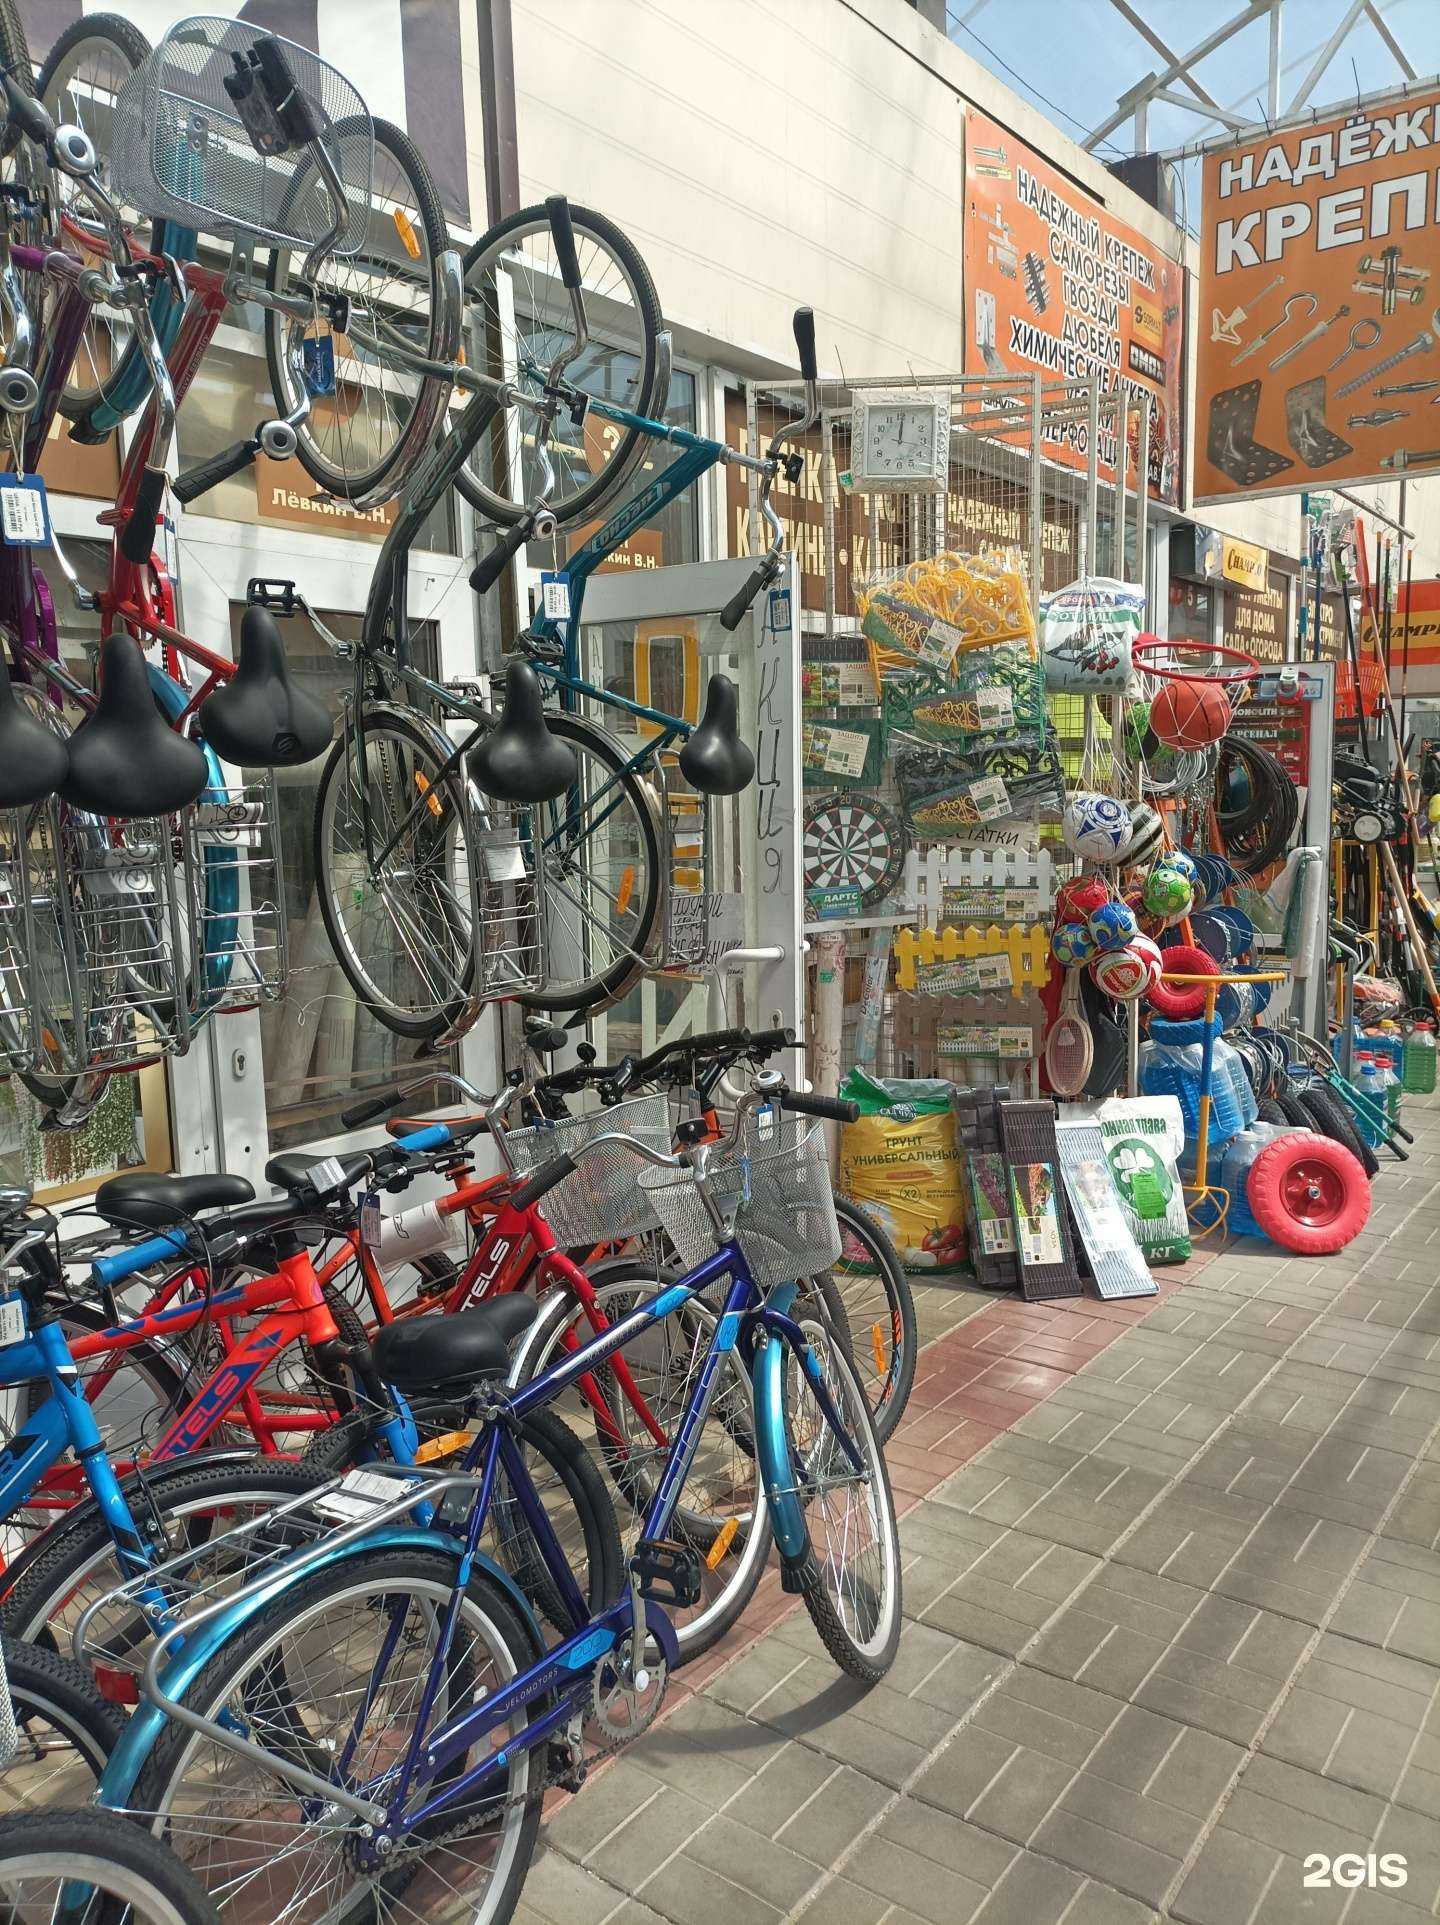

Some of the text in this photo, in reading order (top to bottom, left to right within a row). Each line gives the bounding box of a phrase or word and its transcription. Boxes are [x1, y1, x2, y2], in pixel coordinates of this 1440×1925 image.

[1219, 104, 1440, 199] НАДЁЖ
[1017, 165, 1156, 291] НАДЕЖНЫЙ КРЕПЕЖ
[1215, 167, 1440, 275] КРЕП
[1050, 233, 1130, 306] САМОРЕЗЫ
[1063, 272, 1119, 331] ГВОЗДИ
[1010, 316, 1109, 394] ХИМИЧЕСКИЕ
[1063, 313, 1121, 368] ДЮБЕЛЯ
[873, 438, 880, 446] 9
[920, 437, 927, 446] 3
[897, 461, 902, 469] 6
[908, 459, 914, 467] 5
[272, 488, 347, 516] Лёвкин
[634, 553, 659, 568] В.Н.
[1235, 607, 1275, 634] ДЛЯ ДОМА
[1224, 632, 1246, 655] САДА
[1250, 637, 1283, 663] ОГОРОДА
[824, 892, 858, 903] ДАРТС
[886, 1136, 923, 1148] ГРУНТ
[853, 1149, 961, 1166] УНИВЕРСАЛЬНЫЙ
[158, 1371, 240, 1461] TELS
[504, 1667, 559, 1711] VELOMOTORS
